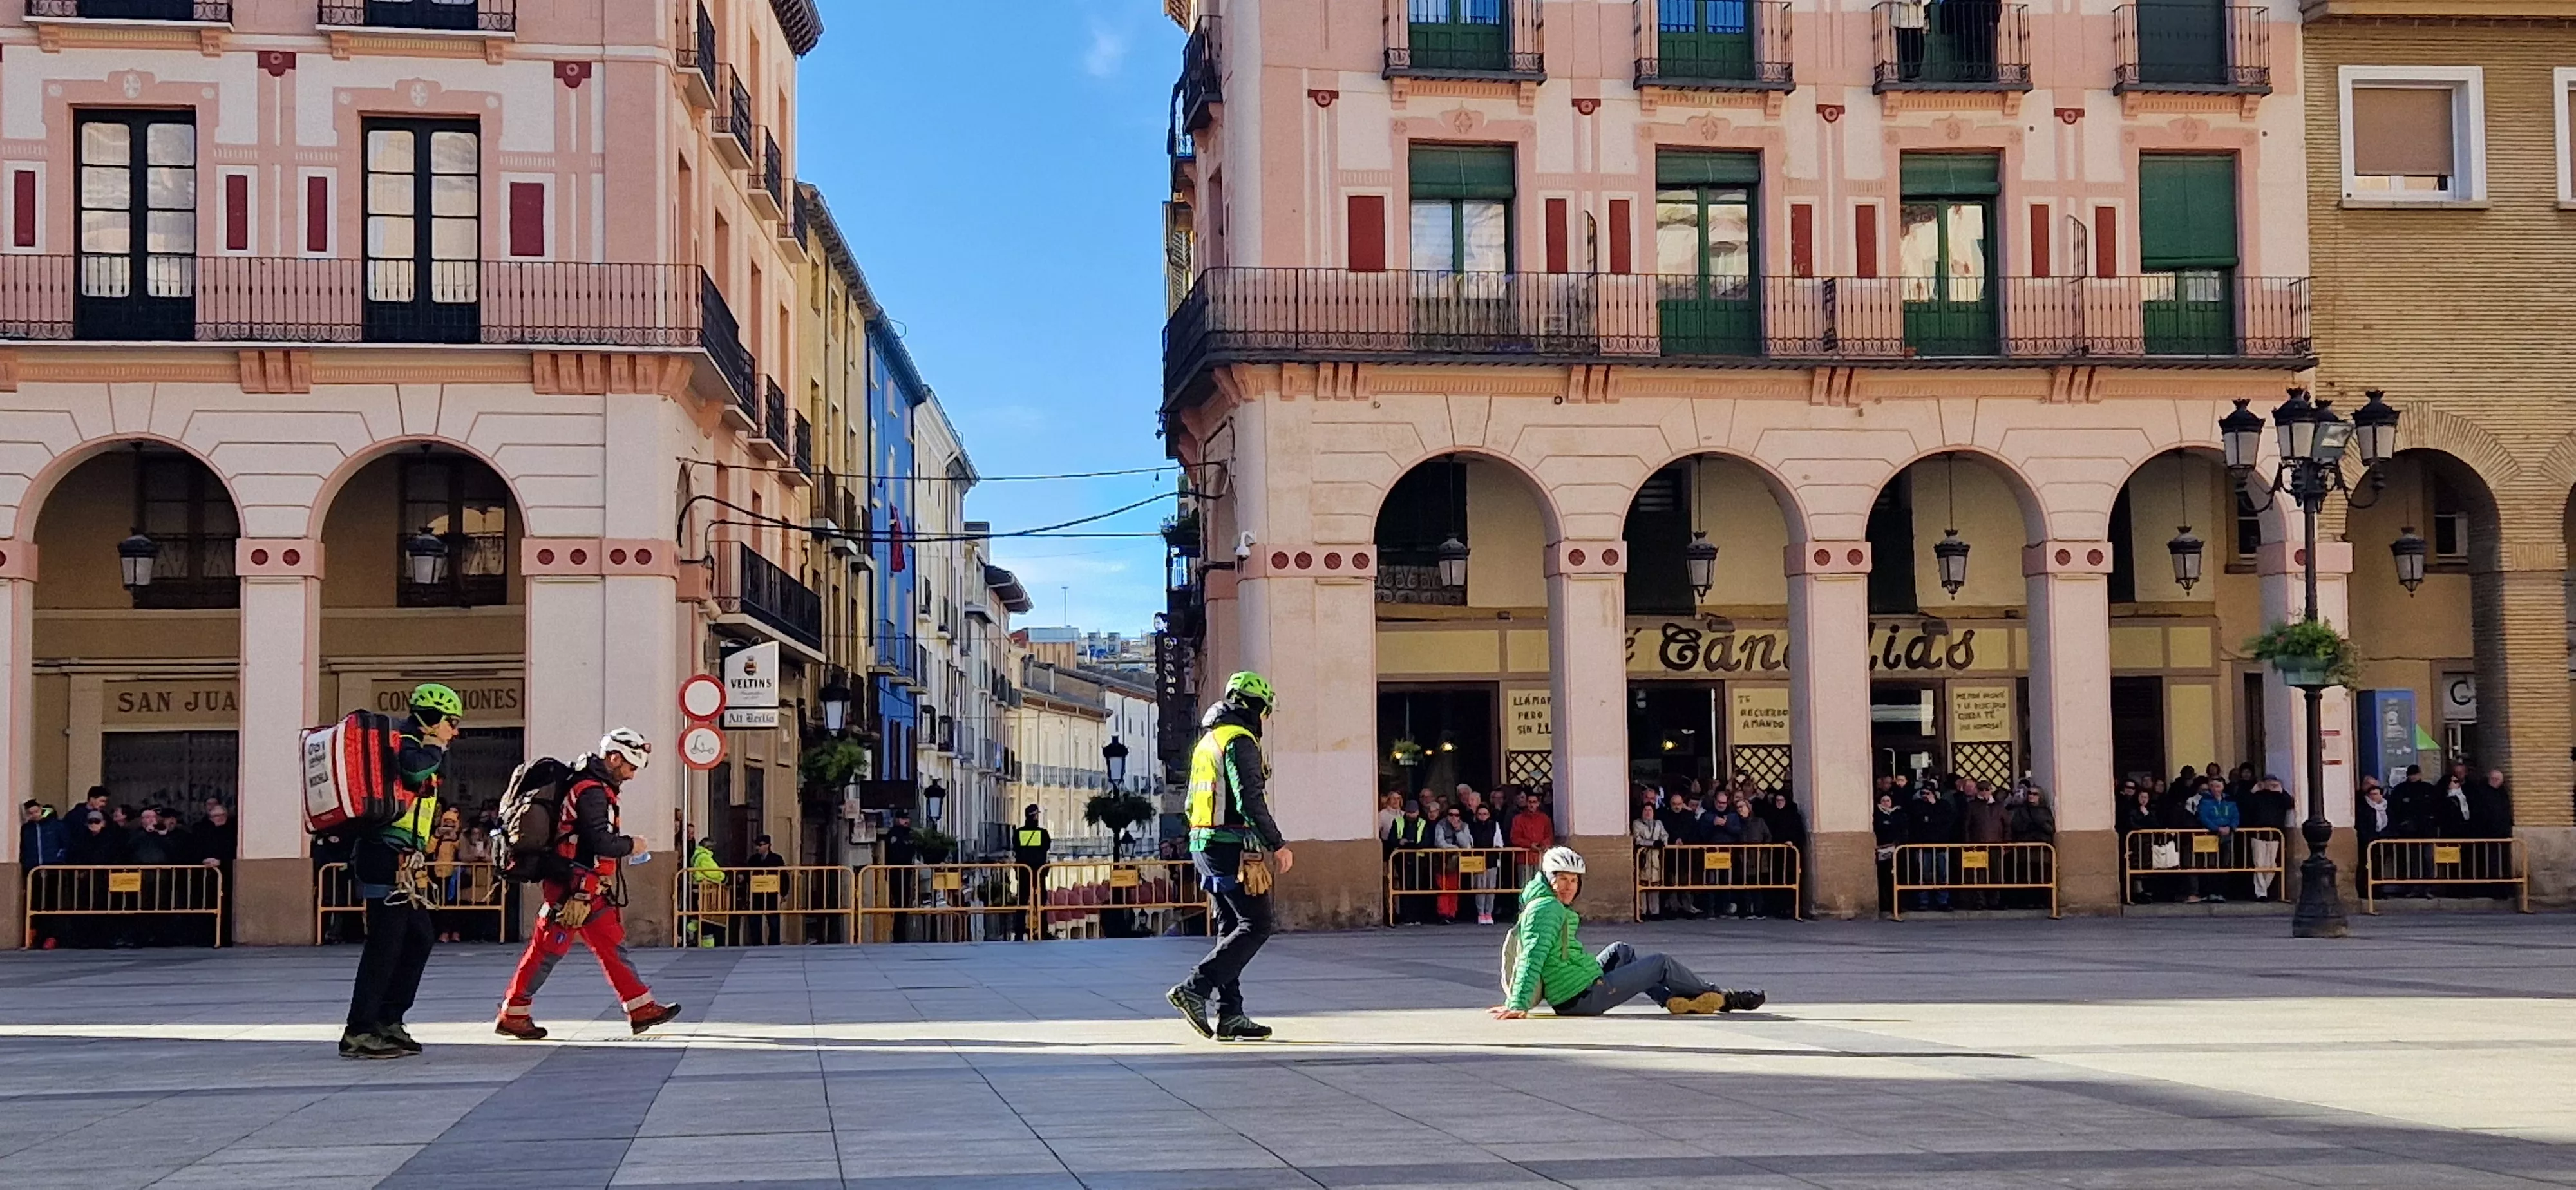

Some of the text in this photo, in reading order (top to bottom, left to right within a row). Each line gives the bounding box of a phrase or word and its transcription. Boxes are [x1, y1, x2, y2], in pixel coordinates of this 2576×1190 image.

[731, 678, 772, 689] VELTINS
[118, 691, 238, 713] SAN JUA
[377, 688, 518, 712] CONIONES
